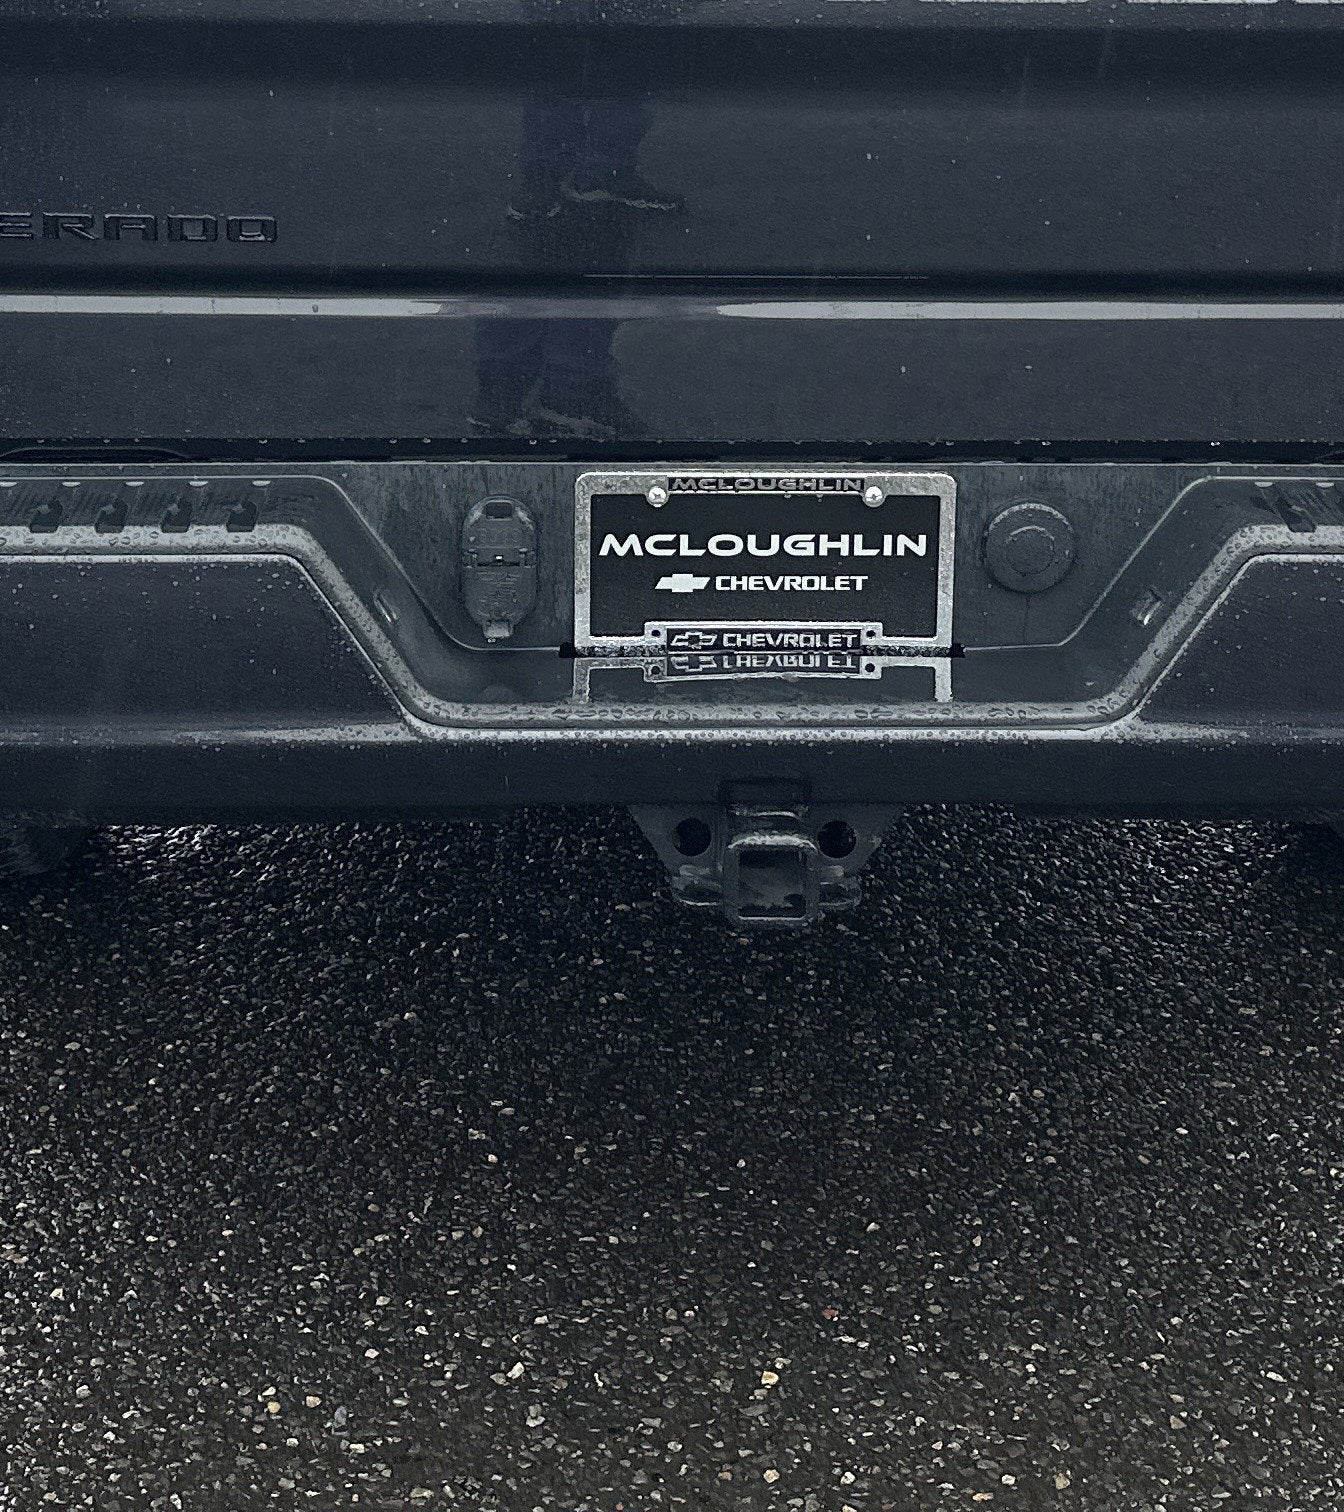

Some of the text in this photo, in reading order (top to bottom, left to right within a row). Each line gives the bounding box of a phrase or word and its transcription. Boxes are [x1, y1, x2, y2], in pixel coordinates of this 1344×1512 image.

[671, 477, 862, 491] MCLOUGHLIN
[599, 533, 927, 557] MCLOUGHLIN
[715, 575, 868, 591] CHEVROLET
[722, 633, 858, 648] CHEVROLET
